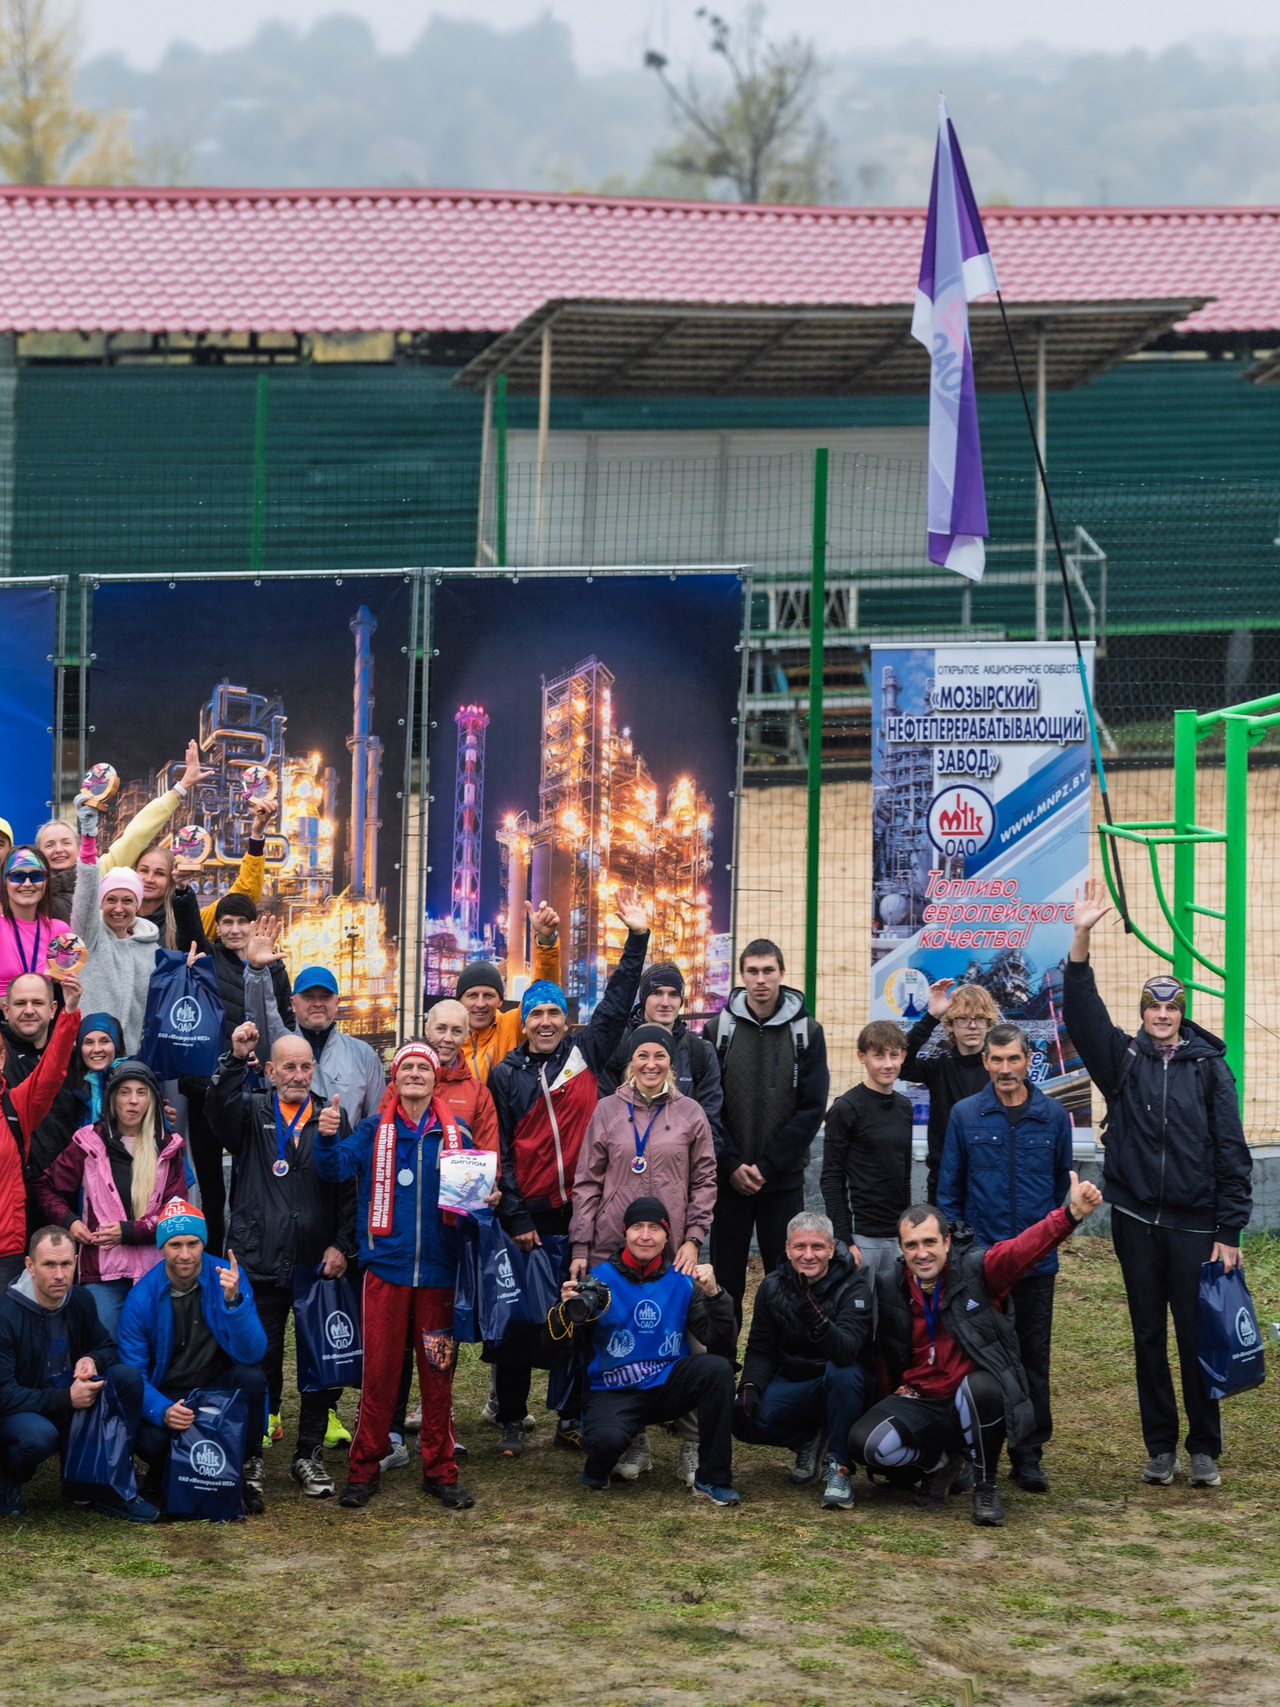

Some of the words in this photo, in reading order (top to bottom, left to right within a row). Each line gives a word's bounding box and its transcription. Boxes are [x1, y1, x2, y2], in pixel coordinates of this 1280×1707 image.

[937, 665, 980, 675] ОТКРЫТОЕ
[983, 664, 1042, 676] АКЦИОНЕРНОЕ
[1043, 664, 1087, 675] ОБЩЕСТВ
[932, 678, 1037, 709] «МОЗЫРСКИЙ
[888, 709, 1085, 744] НЕФТЕПЕРЕРАБАТЫВАЮЩИЙ
[937, 748, 998, 776] ЗАВОД»
[1000, 770, 1087, 843] WWW.MNPZ.BY
[945, 839, 977, 857] ОАО
[925, 871, 1018, 897] Топливо
[923, 898, 1077, 930] европейского
[919, 922, 1033, 948] качества!
[450, 1159, 487, 1168] ДИПЛОМ
[372, 1182, 384, 1228] ВЛАДИМИР
[161, 1216, 192, 1229] SKA
